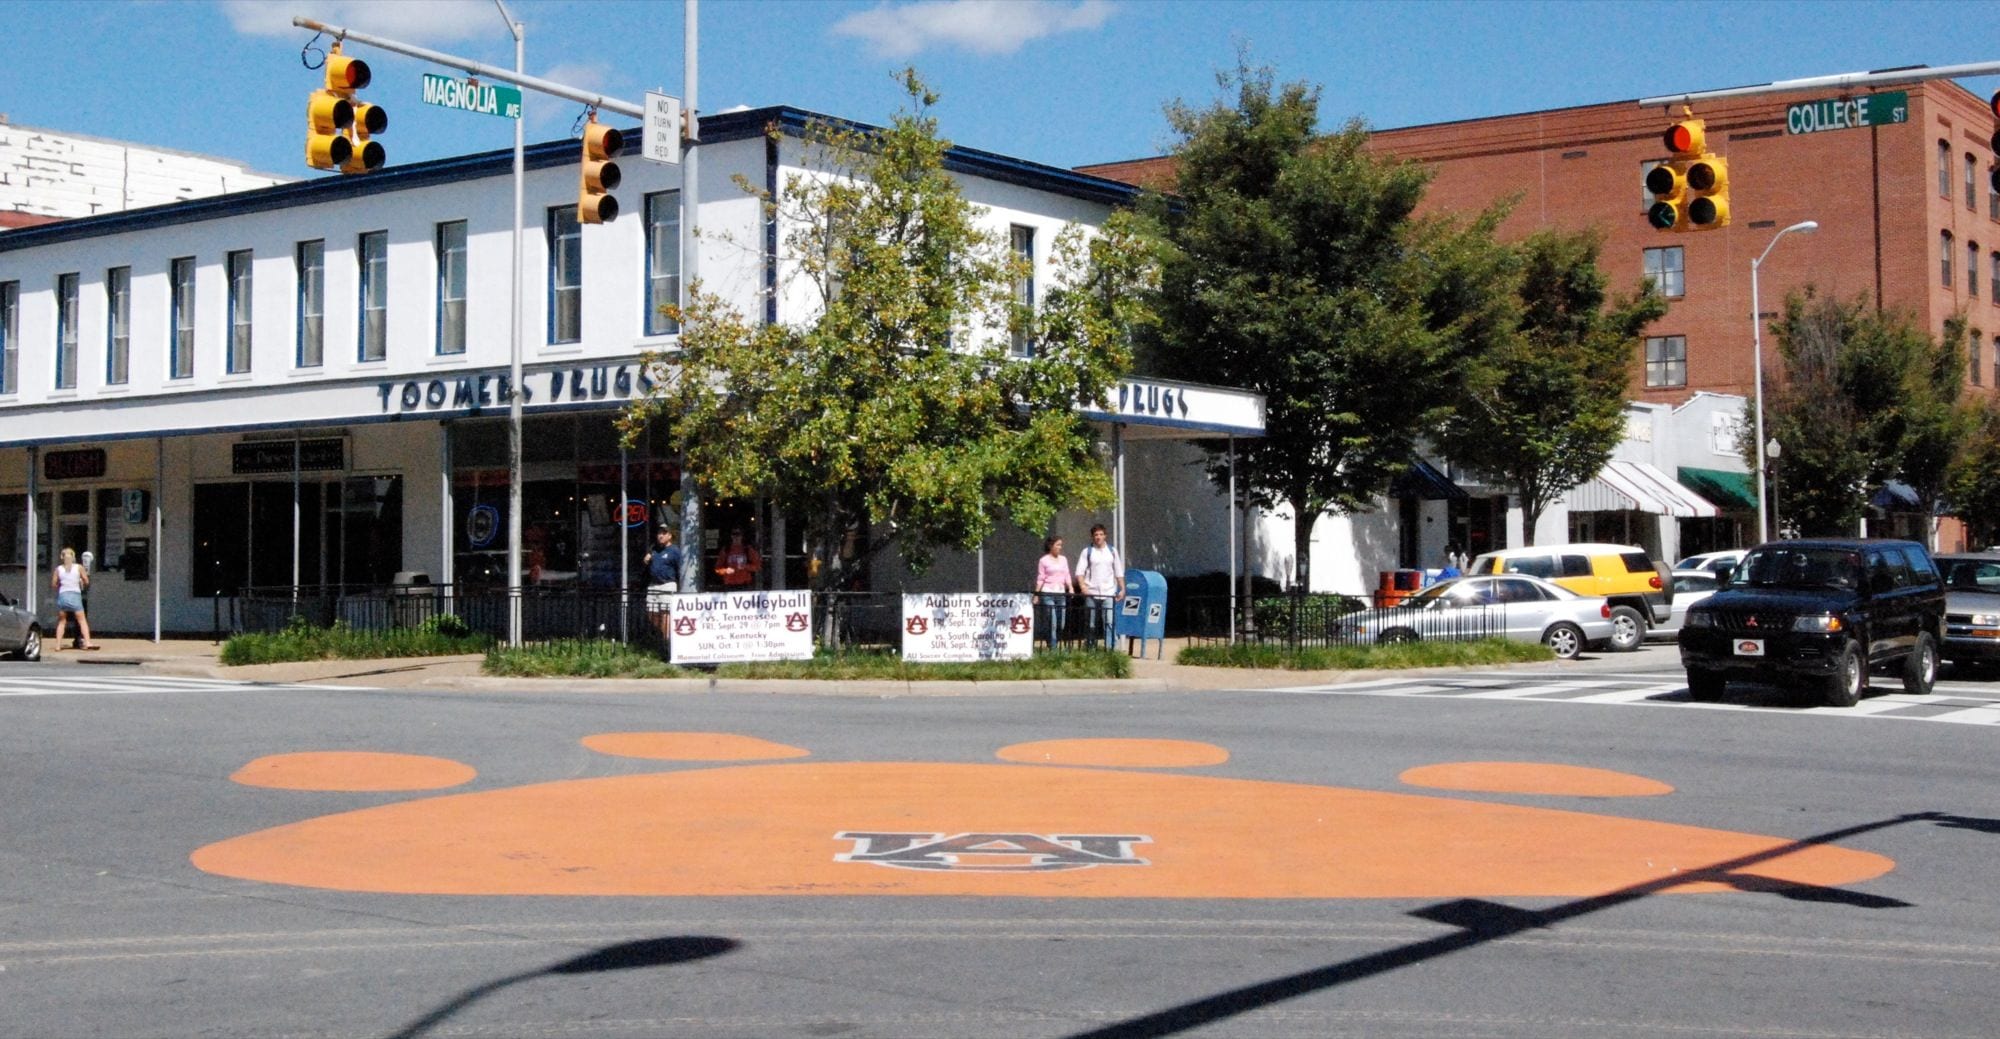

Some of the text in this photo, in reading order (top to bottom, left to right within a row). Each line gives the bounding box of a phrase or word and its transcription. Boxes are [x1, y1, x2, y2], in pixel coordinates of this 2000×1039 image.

[423, 75, 520, 118] MAGNOLIA AVE
[657, 100, 669, 114] NO
[653, 115, 672, 129] TURN
[1788, 98, 1905, 134] COLLEGE ST
[656, 131, 667, 142] ON
[654, 145, 669, 158] RED
[550, 363, 654, 401] DRUGS
[1119, 383, 1188, 419] DRUGS
[613, 503, 649, 522] OPEN
[676, 593, 806, 612] Auburn Volleyball
[926, 595, 1014, 608] Auburn Soccer
[723, 613, 777, 621] Tennessee
[961, 609, 996, 618] Florida
[729, 631, 767, 640] Kentucky
[948, 632, 969, 640] South
[973, 631, 1005, 640] Carolina
